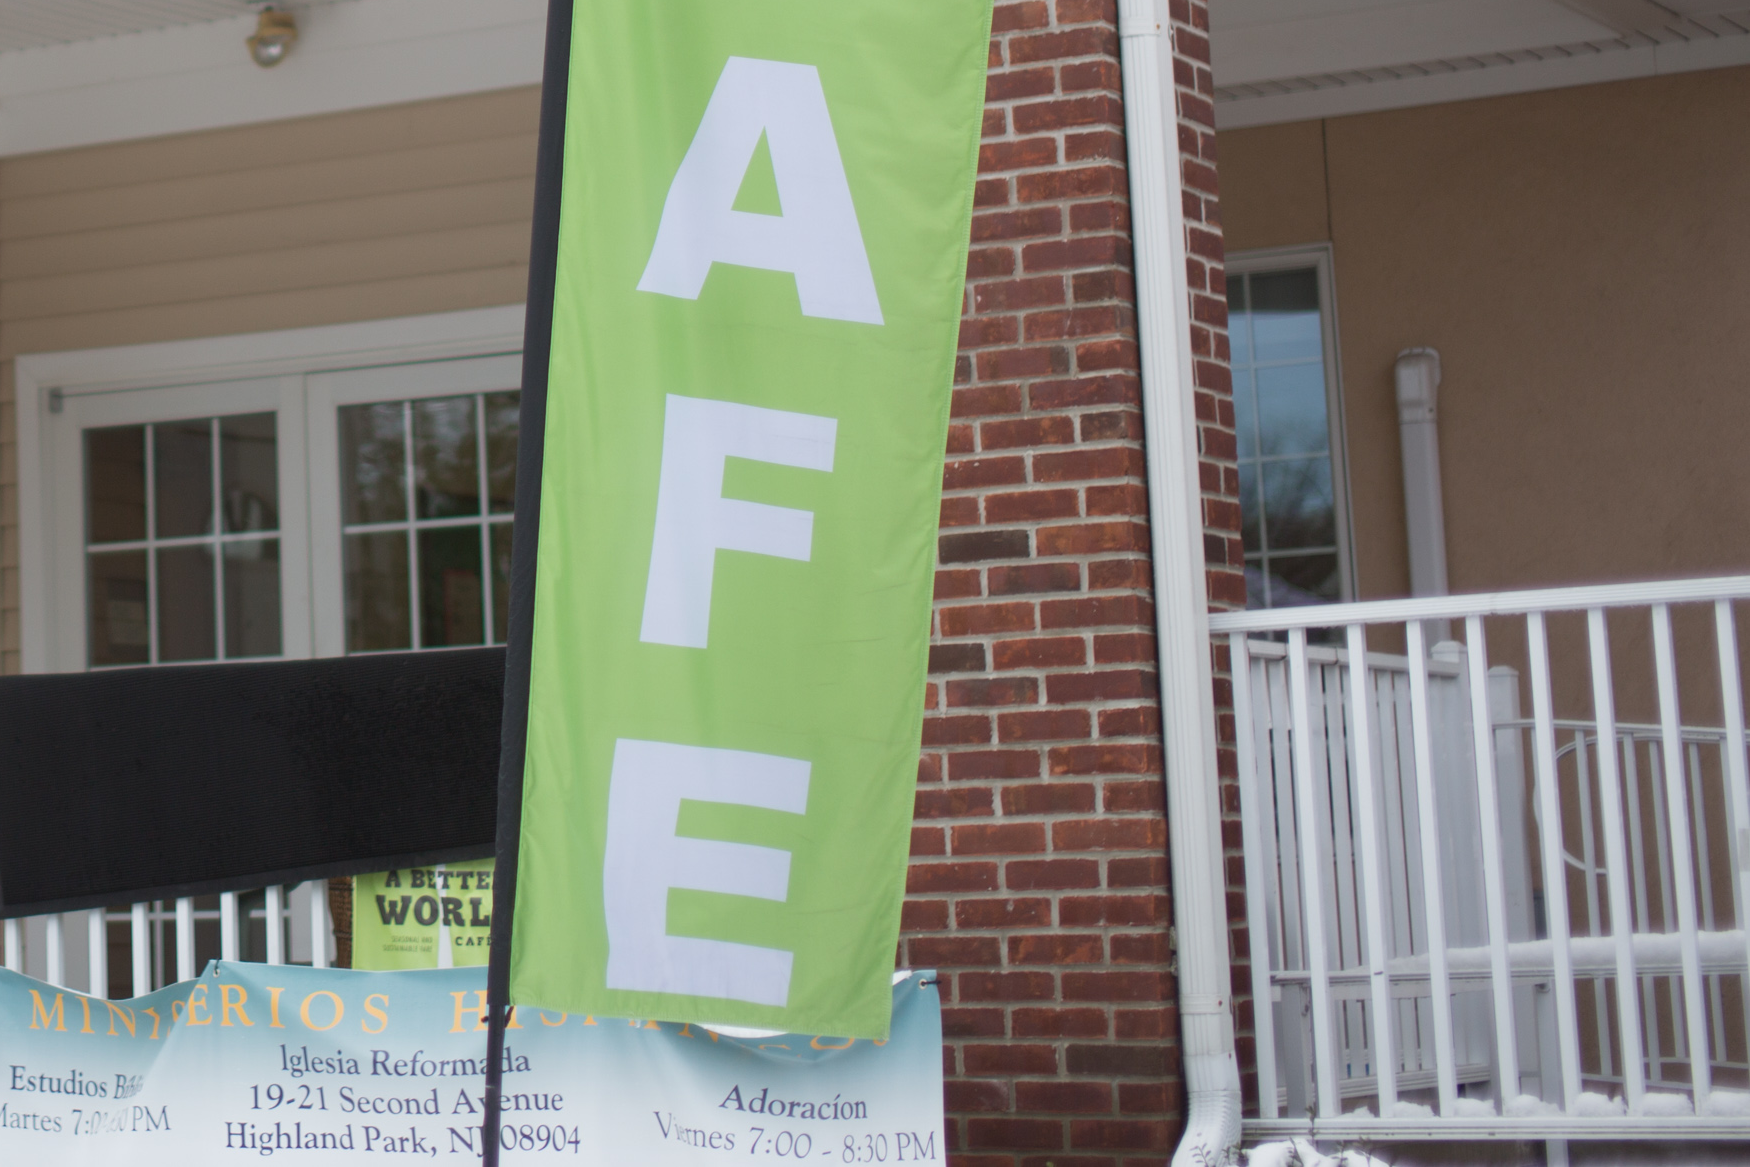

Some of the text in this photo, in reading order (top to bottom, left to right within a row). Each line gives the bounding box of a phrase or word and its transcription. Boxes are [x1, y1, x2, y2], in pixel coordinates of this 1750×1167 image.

[385, 869, 492, 890] A BETTE
[376, 894, 491, 927] WORL
[280, 1043, 361, 1078] Iglesia
[9, 1065, 108, 1098] Estudios
[249, 1083, 329, 1111] 19-21
[339, 1085, 441, 1115] Second
[131, 1105, 172, 1132] PM
[224, 1121, 354, 1156] Highland
[362, 1126, 438, 1157] Park,
[500, 1124, 581, 1154] 08904
[653, 1110, 736, 1151] Viernes
[749, 1126, 813, 1159] 7:00
[841, 1133, 888, 1164] 8:30
[895, 1130, 937, 1162] PM
